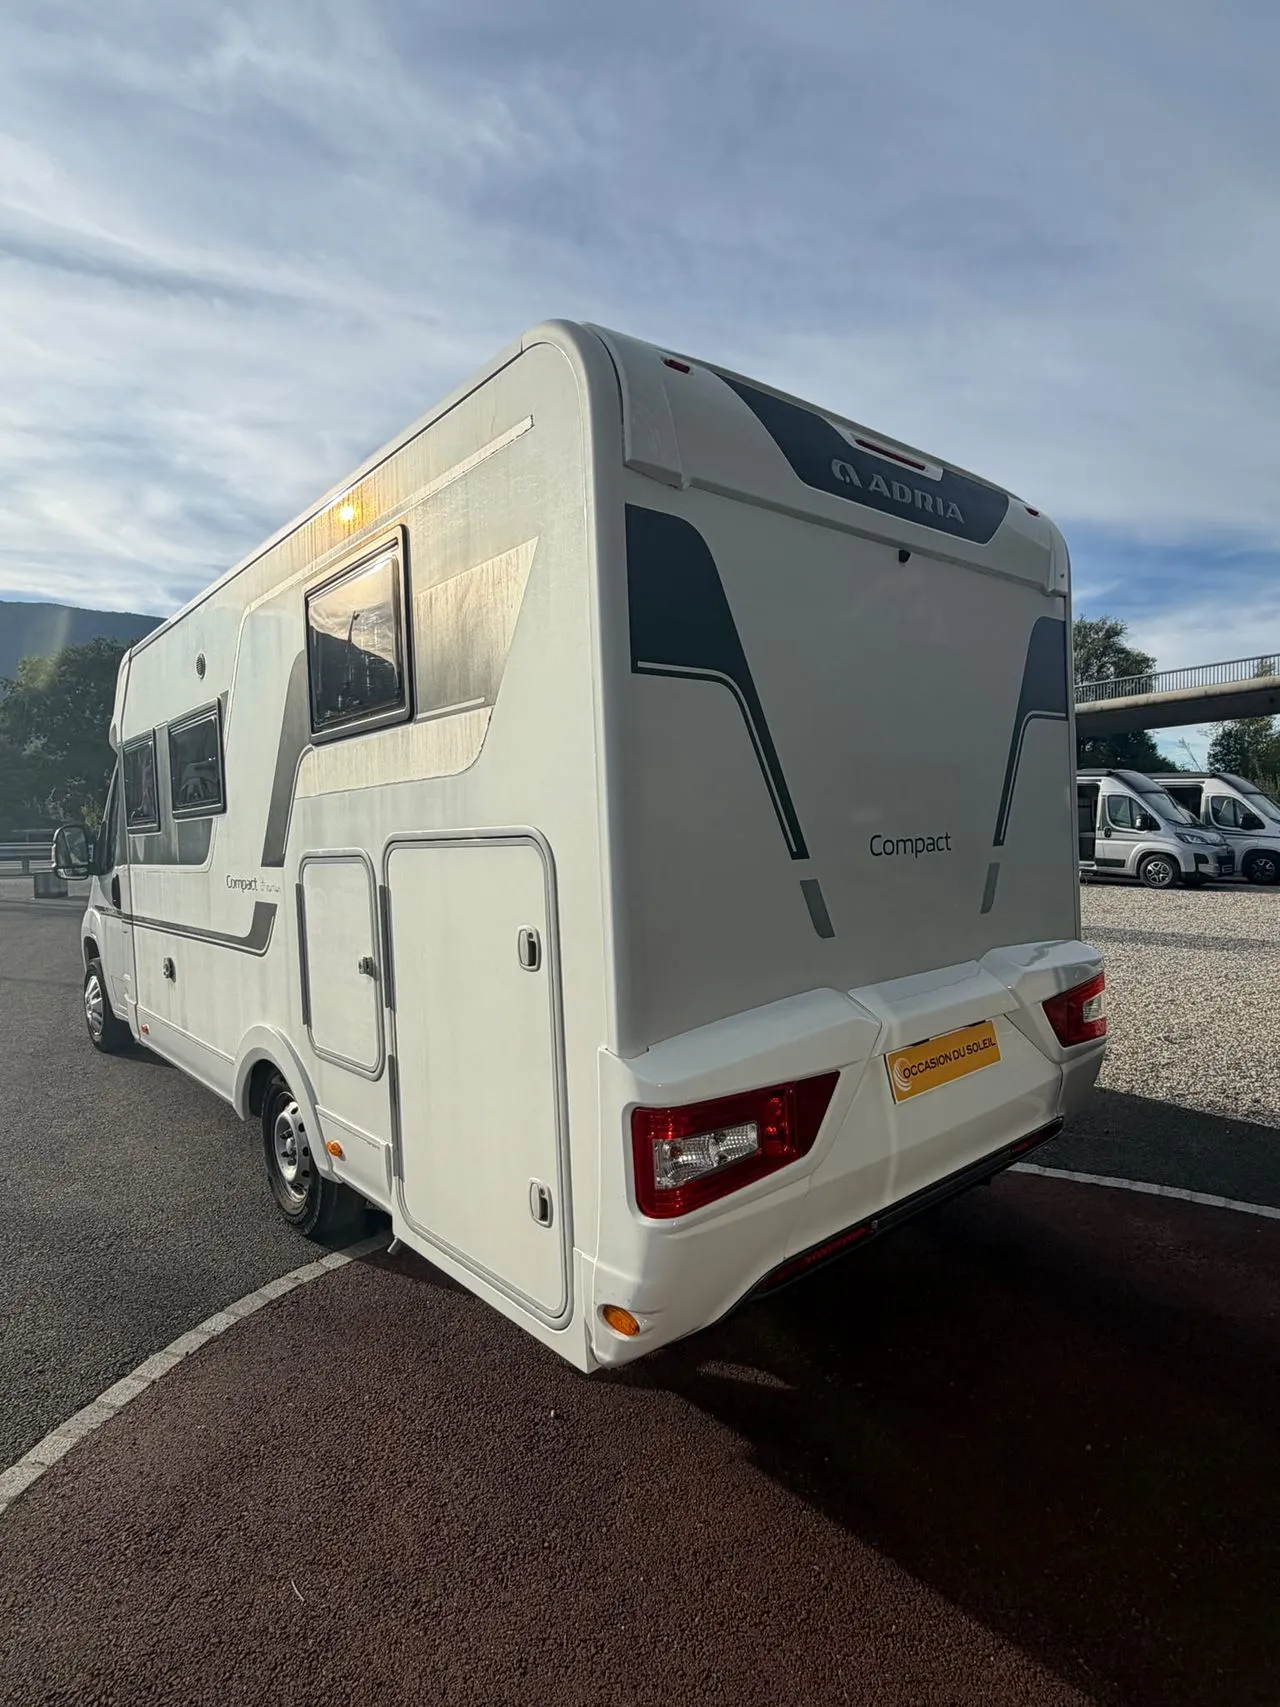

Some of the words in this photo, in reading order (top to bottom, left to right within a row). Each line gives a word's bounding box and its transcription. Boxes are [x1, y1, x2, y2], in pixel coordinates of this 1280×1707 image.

[868, 473, 965, 524] ADRIA
[869, 831, 952, 859] Compact
[226, 874, 258, 894] Compact
[902, 1051, 953, 1079] OCCASION
[952, 1047, 966, 1060] DU
[966, 1037, 997, 1056] SOLEIL
